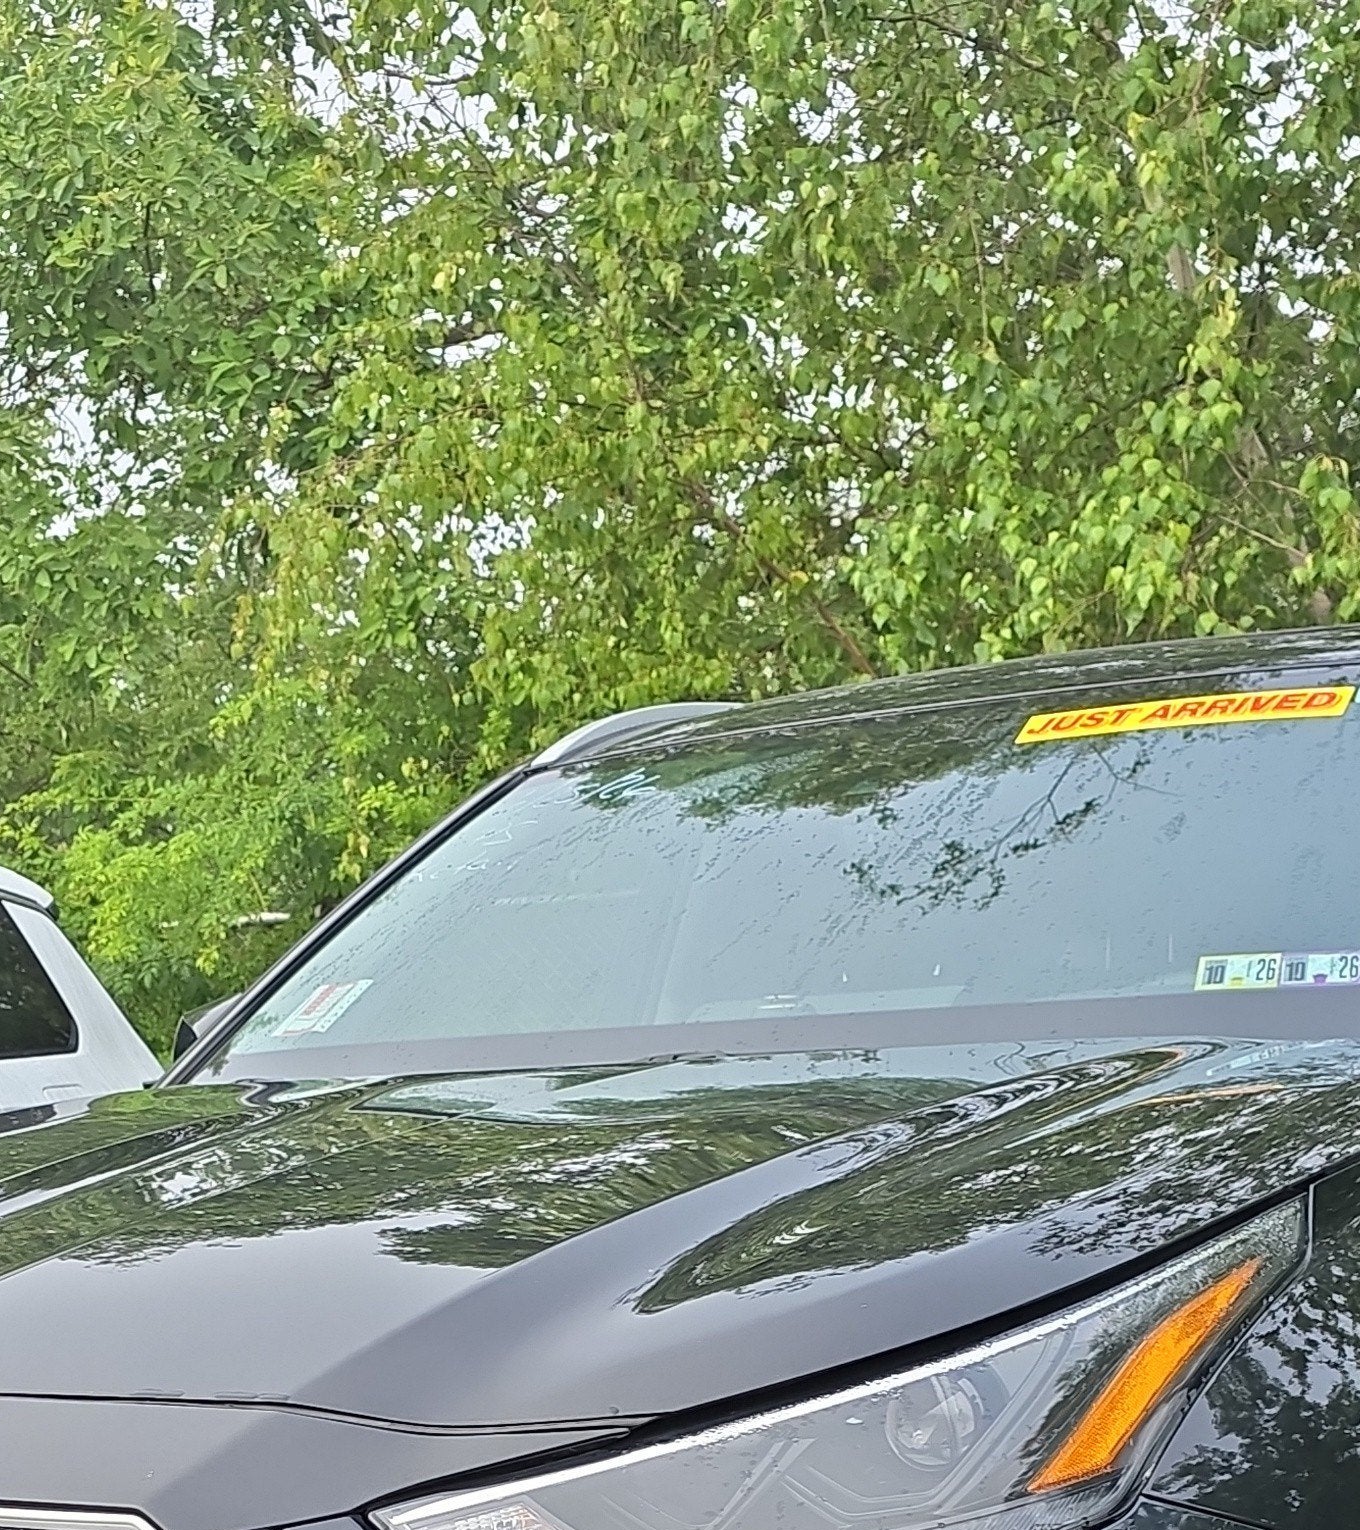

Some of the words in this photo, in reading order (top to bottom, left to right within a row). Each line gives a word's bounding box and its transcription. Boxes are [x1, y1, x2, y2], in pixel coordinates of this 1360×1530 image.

[1028, 707, 1139, 735] JUST
[1141, 692, 1341, 722] ARRIVED
[1205, 964, 1226, 985] 10
[1255, 958, 1277, 981] 26
[1285, 961, 1306, 982] 10
[1338, 955, 1360, 979] 26
